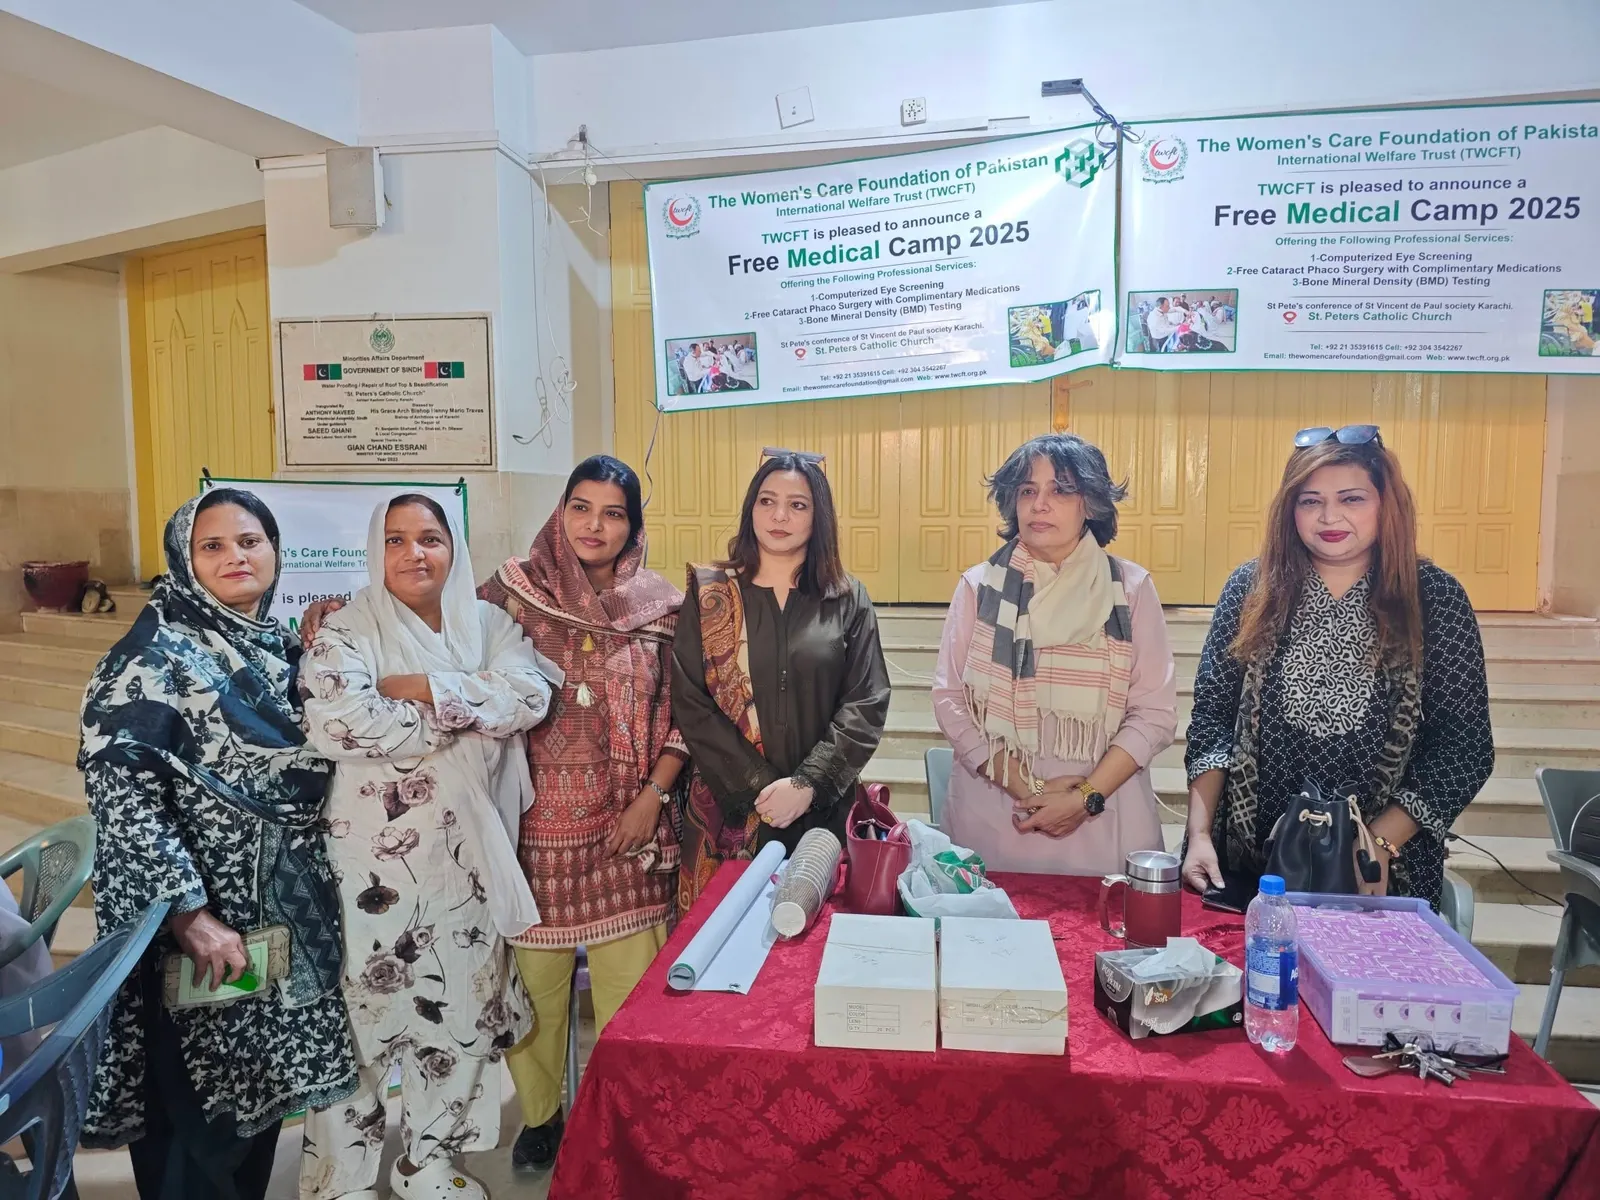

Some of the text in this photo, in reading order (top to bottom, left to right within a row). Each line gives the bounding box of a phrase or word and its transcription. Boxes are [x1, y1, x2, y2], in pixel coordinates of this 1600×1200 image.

[1197, 123, 1598, 152] The Women's Care Foundation of Pakista
[1277, 146, 1520, 165] International Welfare Trust (TWCFT)
[708, 155, 1048, 208] The Women's Care Foundation of Pakistan
[1257, 178, 1526, 196] TWCFT is pleased to announce a
[776, 182, 975, 216] International Welfare Trust (TWCFT)
[1214, 196, 1580, 226] Free Medical Camp 2025
[761, 209, 982, 244] TWCFT is pleased to announce a
[728, 220, 1029, 275] Free Medical Camp 2025
[1275, 233, 1513, 247] Offering the Following Professional Services:
[1310, 251, 1472, 263] 1-Computerized Eye Screening
[780, 261, 976, 289] Offering the Following Professional Services:
[1226, 263, 1561, 275] 2-Free Cataract Phaco Surgery with Complimentary Medications
[810, 280, 944, 301] 1-Computerized Eye Screening
[1292, 276, 1490, 287] 3-Bone Mineral Density (BMD) Testing
[744, 284, 1020, 320] 2-Free Cataract Phaco Surgery with Complimentary Medications
[1444, 302, 1475, 311] society
[798, 301, 962, 325] 3-Bone Mineral Density (BMD) Testing
[1308, 311, 1452, 321] St. Peters Catholic Church
[811, 336, 850, 345] conference
[869, 331, 896, 339] Vincent
[925, 326, 952, 334] society
[953, 322, 984, 331] Karachi.
[815, 335, 934, 355] St. Peters Catholic Church
[1288, 352, 1422, 361] thewomencarefoundation@gmail.com
[301, 548, 329, 557] Care
[282, 593, 294, 604] is
